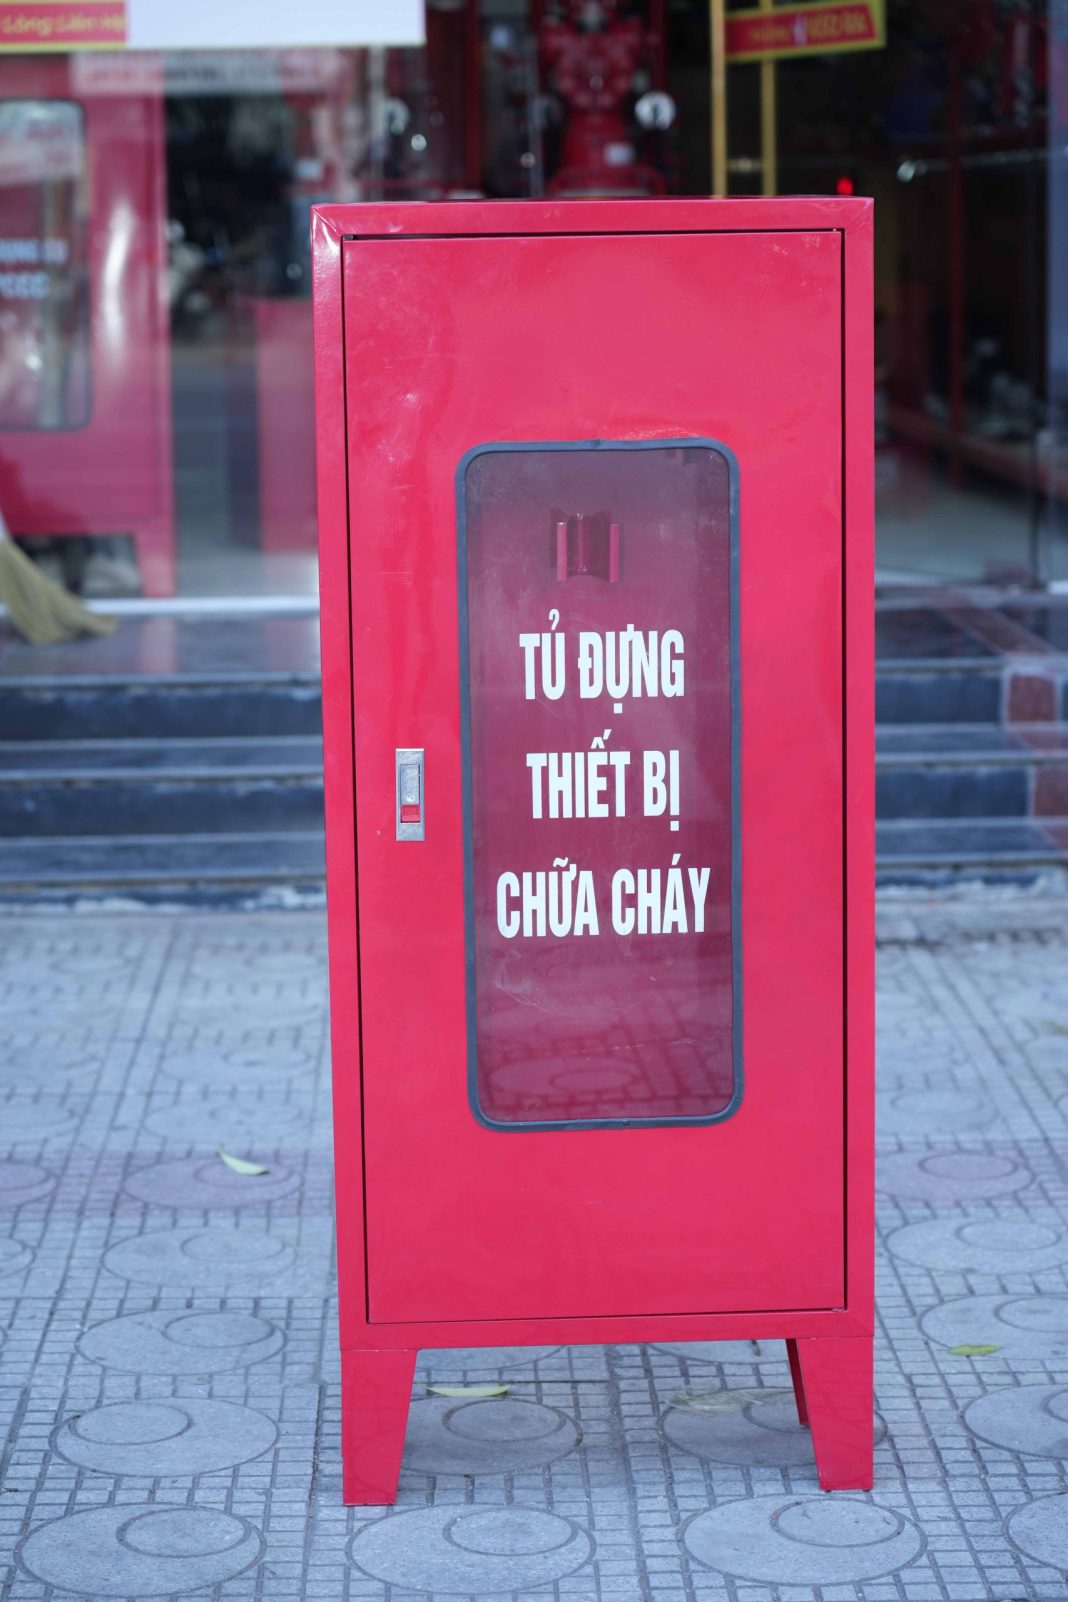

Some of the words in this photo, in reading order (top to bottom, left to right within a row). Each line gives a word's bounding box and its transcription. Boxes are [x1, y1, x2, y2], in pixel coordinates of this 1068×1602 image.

[519, 608, 566, 700] TỦ
[578, 624, 685, 714] ĐỰNG
[526, 729, 631, 819] THIẾT
[643, 750, 680, 831] BỊ
[496, 857, 600, 938] CHỮA
[611, 853, 711, 936] CHÁY
